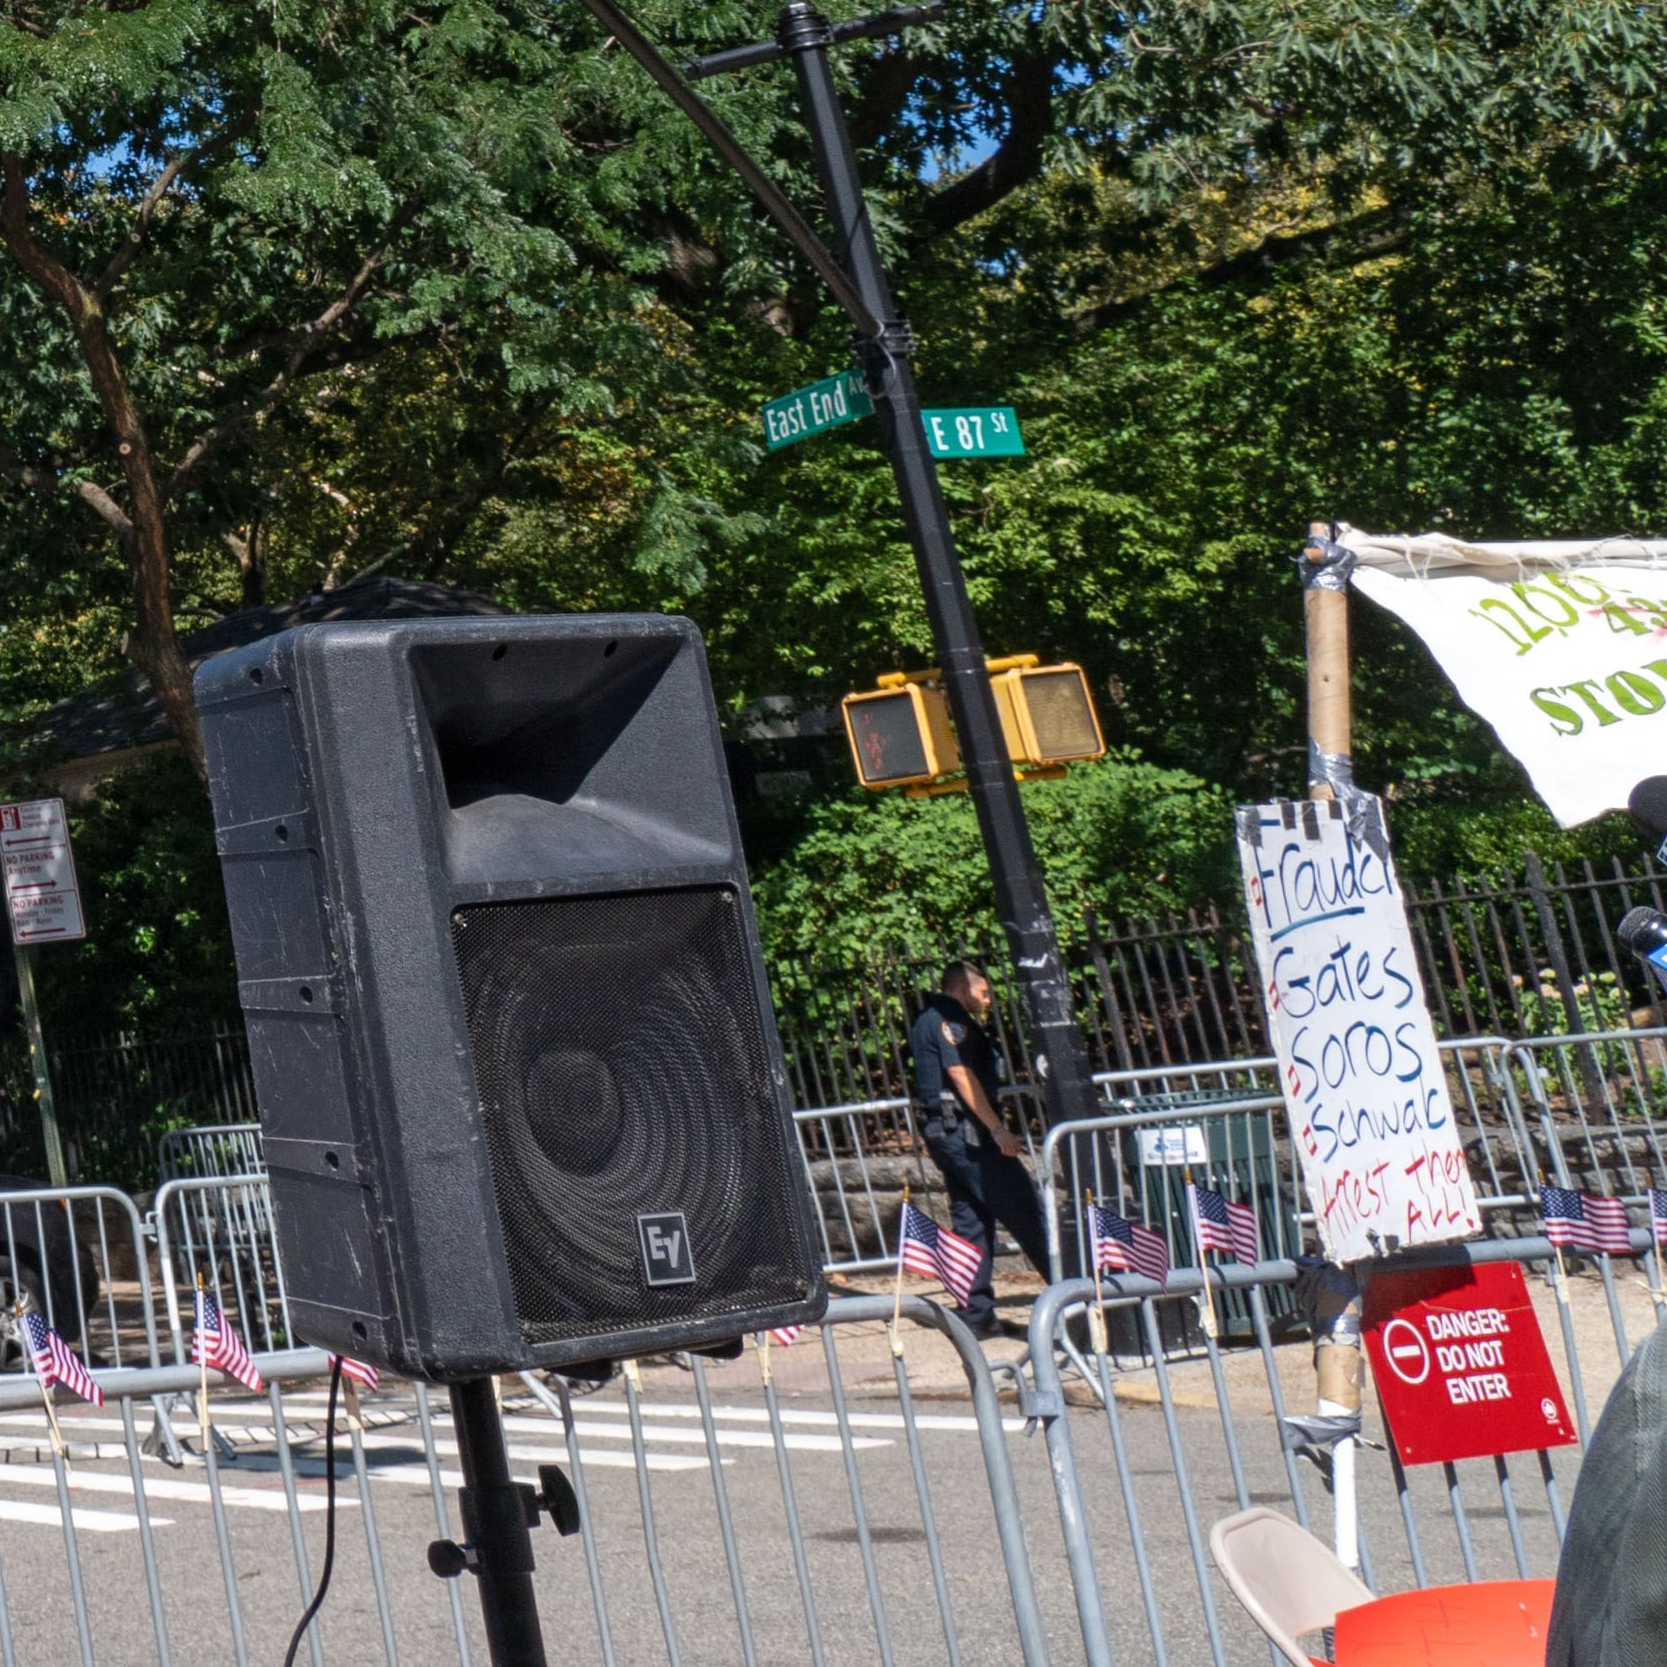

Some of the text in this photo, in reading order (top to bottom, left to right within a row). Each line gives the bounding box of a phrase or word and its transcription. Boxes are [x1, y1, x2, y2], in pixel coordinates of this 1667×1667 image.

[767, 396, 807, 442] East
[810, 379, 847, 425] End
[930, 412, 1009, 451] E 87 St
[6, 851, 55, 866] NO PARKING
[13, 894, 64, 909] NO PARKING
[1274, 934, 1413, 1018] Gates
[1291, 1020, 1423, 1104] Soros
[1321, 1158, 1390, 1241] Arrest
[1407, 1186, 1475, 1245] ALL!
[647, 1225, 681, 1269] EV
[1426, 1308, 1510, 1340] DANGER:
[1435, 1340, 1504, 1372] DO NOT
[1446, 1373, 1511, 1405] ENTER
